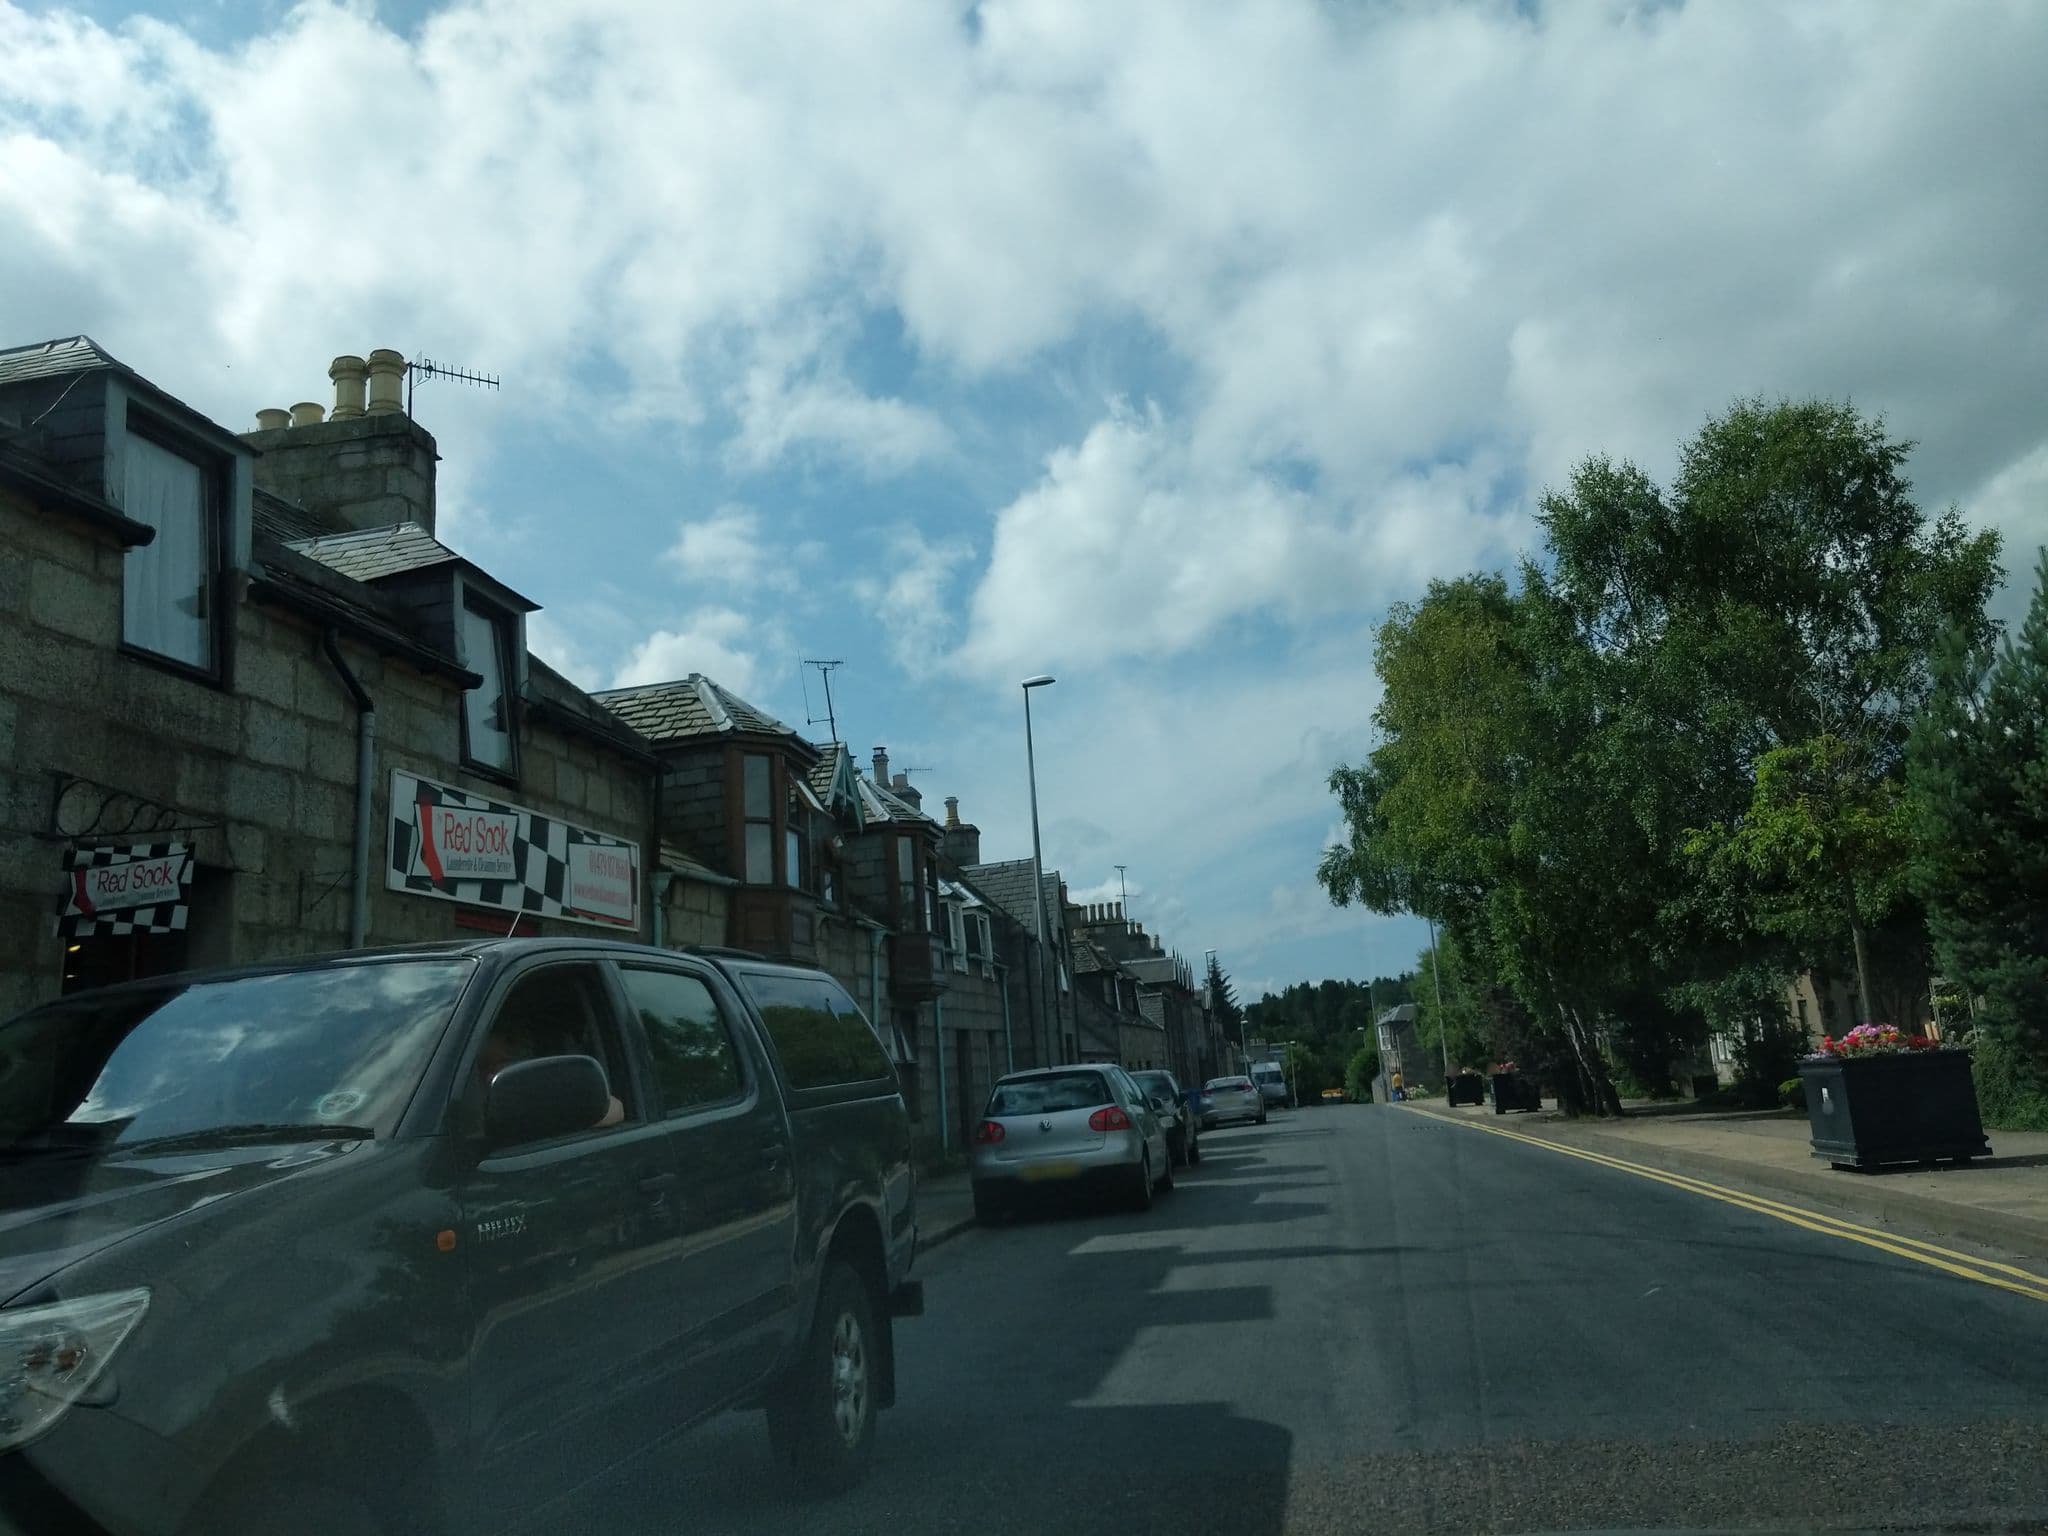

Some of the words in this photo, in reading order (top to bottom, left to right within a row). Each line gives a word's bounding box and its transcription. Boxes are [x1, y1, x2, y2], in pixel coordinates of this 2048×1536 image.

[443, 813, 472, 852] Red
[476, 816, 510, 855] Sock
[97, 868, 128, 892] Red
[133, 862, 173, 889] Sock
